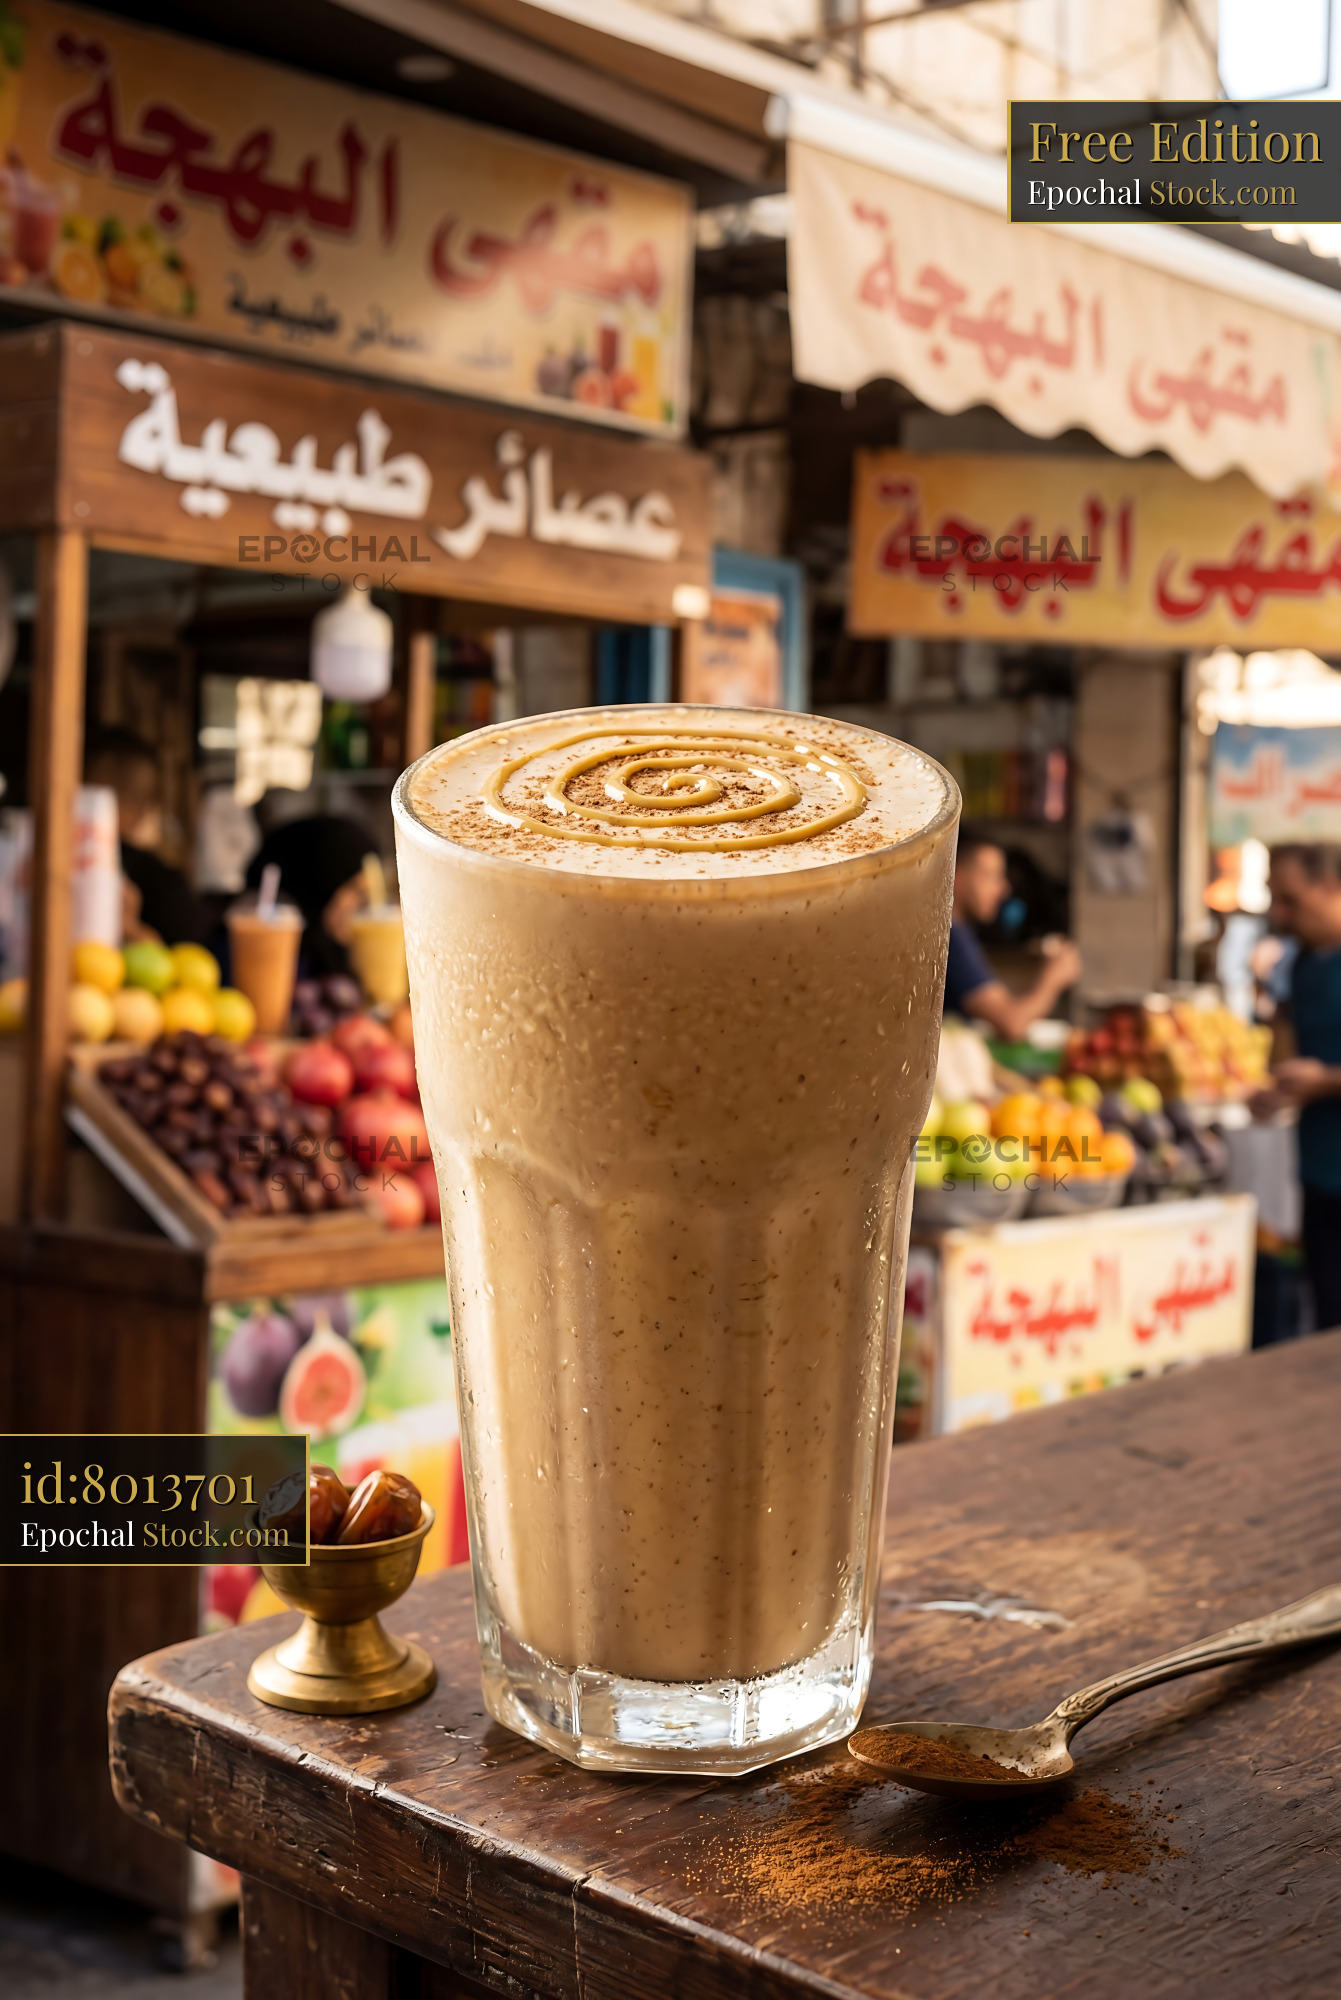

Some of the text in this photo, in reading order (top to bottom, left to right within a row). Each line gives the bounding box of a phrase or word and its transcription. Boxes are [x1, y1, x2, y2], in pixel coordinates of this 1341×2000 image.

[56, 30, 663, 314] مقهى البهجة
[851, 200, 1288, 438] مقهى البهجة
[116, 357, 683, 562] عصائر طبيعية
[874, 477, 1133, 622] البهجة
[966, 1254, 1121, 1368] البهجة
